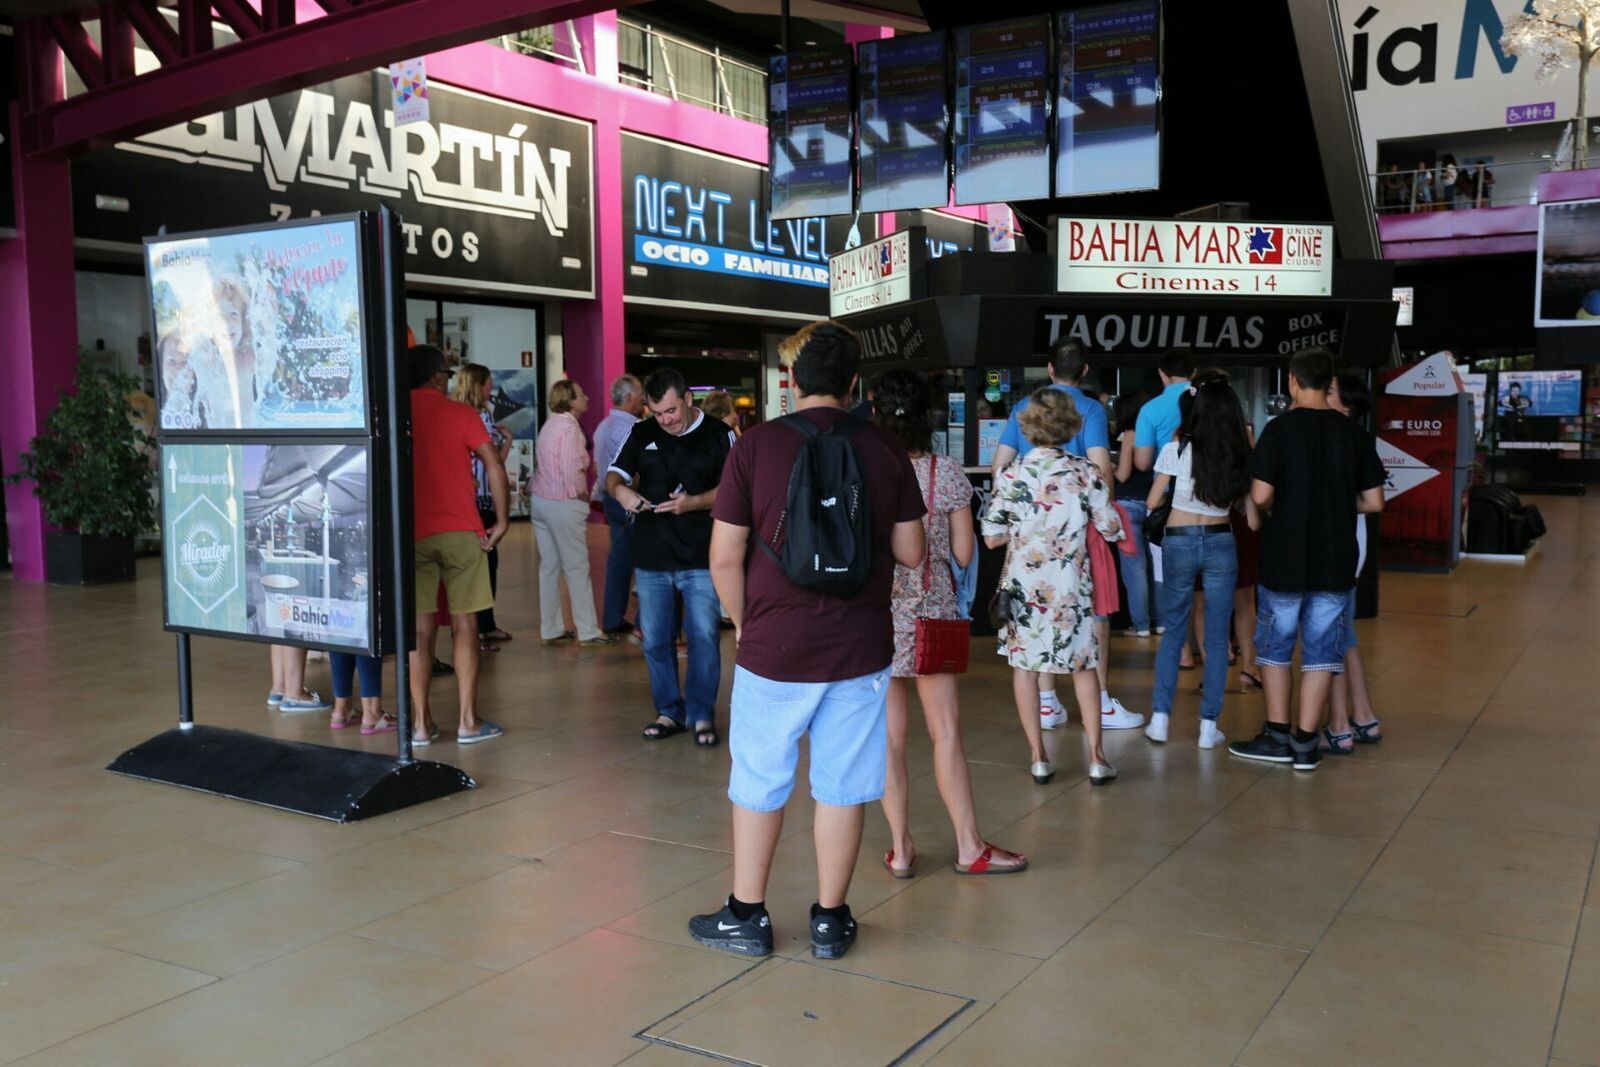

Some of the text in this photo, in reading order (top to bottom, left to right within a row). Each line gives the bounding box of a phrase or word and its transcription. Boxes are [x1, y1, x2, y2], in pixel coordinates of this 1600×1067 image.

[634, 175, 829, 263] NEXT LEVEL
[1068, 220, 1243, 265] BAHIA MAR
[1286, 227, 1323, 236] UNION
[1286, 236, 1322, 258] CINE
[642, 241, 829, 285] OCIO FAMILIAR
[832, 255, 858, 292] BAHIA
[859, 244, 881, 285] MAR
[1285, 257, 1322, 266] CIUDAD
[1115, 271, 1278, 292] Cinemas 14
[844, 291, 881, 312] Cinemas
[1044, 312, 1324, 351] TAQUILLAS BOX
[1278, 328, 1339, 354] OFFICE
[1413, 382, 1446, 392] Popular
[1407, 419, 1443, 430] EURO
[181, 541, 230, 563] Mirador
